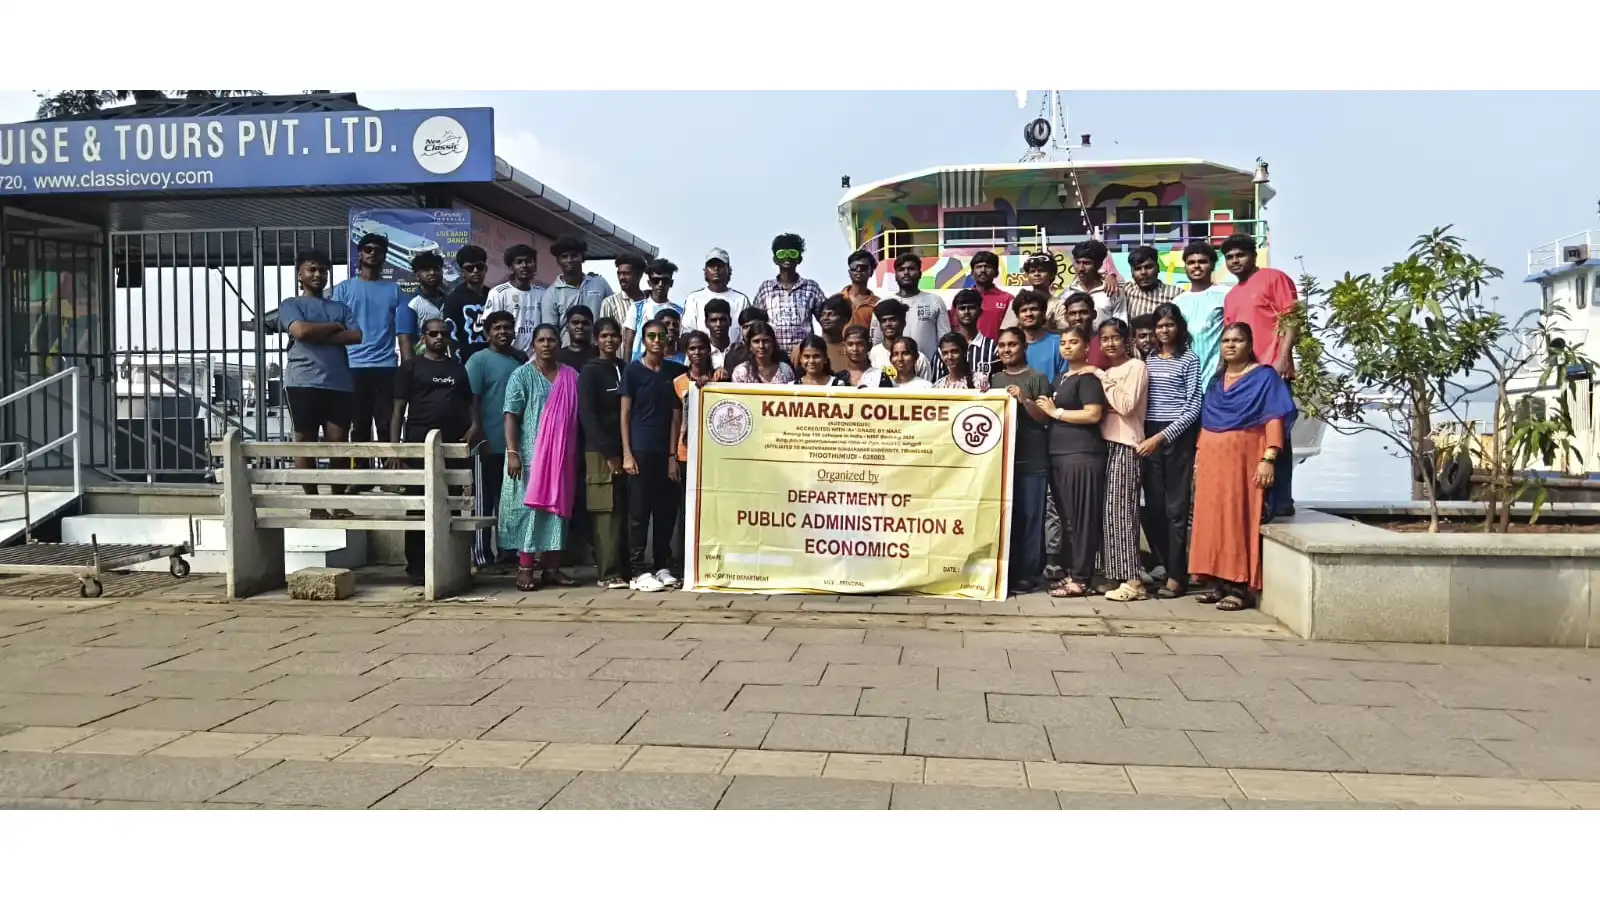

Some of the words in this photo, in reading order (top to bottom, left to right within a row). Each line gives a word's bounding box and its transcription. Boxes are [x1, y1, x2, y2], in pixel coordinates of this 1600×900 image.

[82, 126, 101, 162] &
[115, 121, 224, 161] TOURS
[238, 119, 309, 157] PVT.
[324, 116, 397, 154] LTD.
[424, 143, 457, 152] Classic
[34, 170, 214, 189] www.classicvoy.com
[762, 401, 854, 420] KAMARAJ
[860, 404, 949, 422] COLLEGE
[809, 452, 857, 460] THOOTHUKUDI
[817, 468, 866, 483] Organized
[868, 468, 880, 484] by
[787, 489, 888, 507] DEPARTMENT
[891, 493, 912, 508] OF
[737, 510, 797, 528] PUBLIC
[801, 513, 947, 534] ADMINISTRATION
[952, 520, 965, 535] &
[805, 538, 910, 558] ECONOMICS
[736, 574, 769, 582] DEPARTMENT
